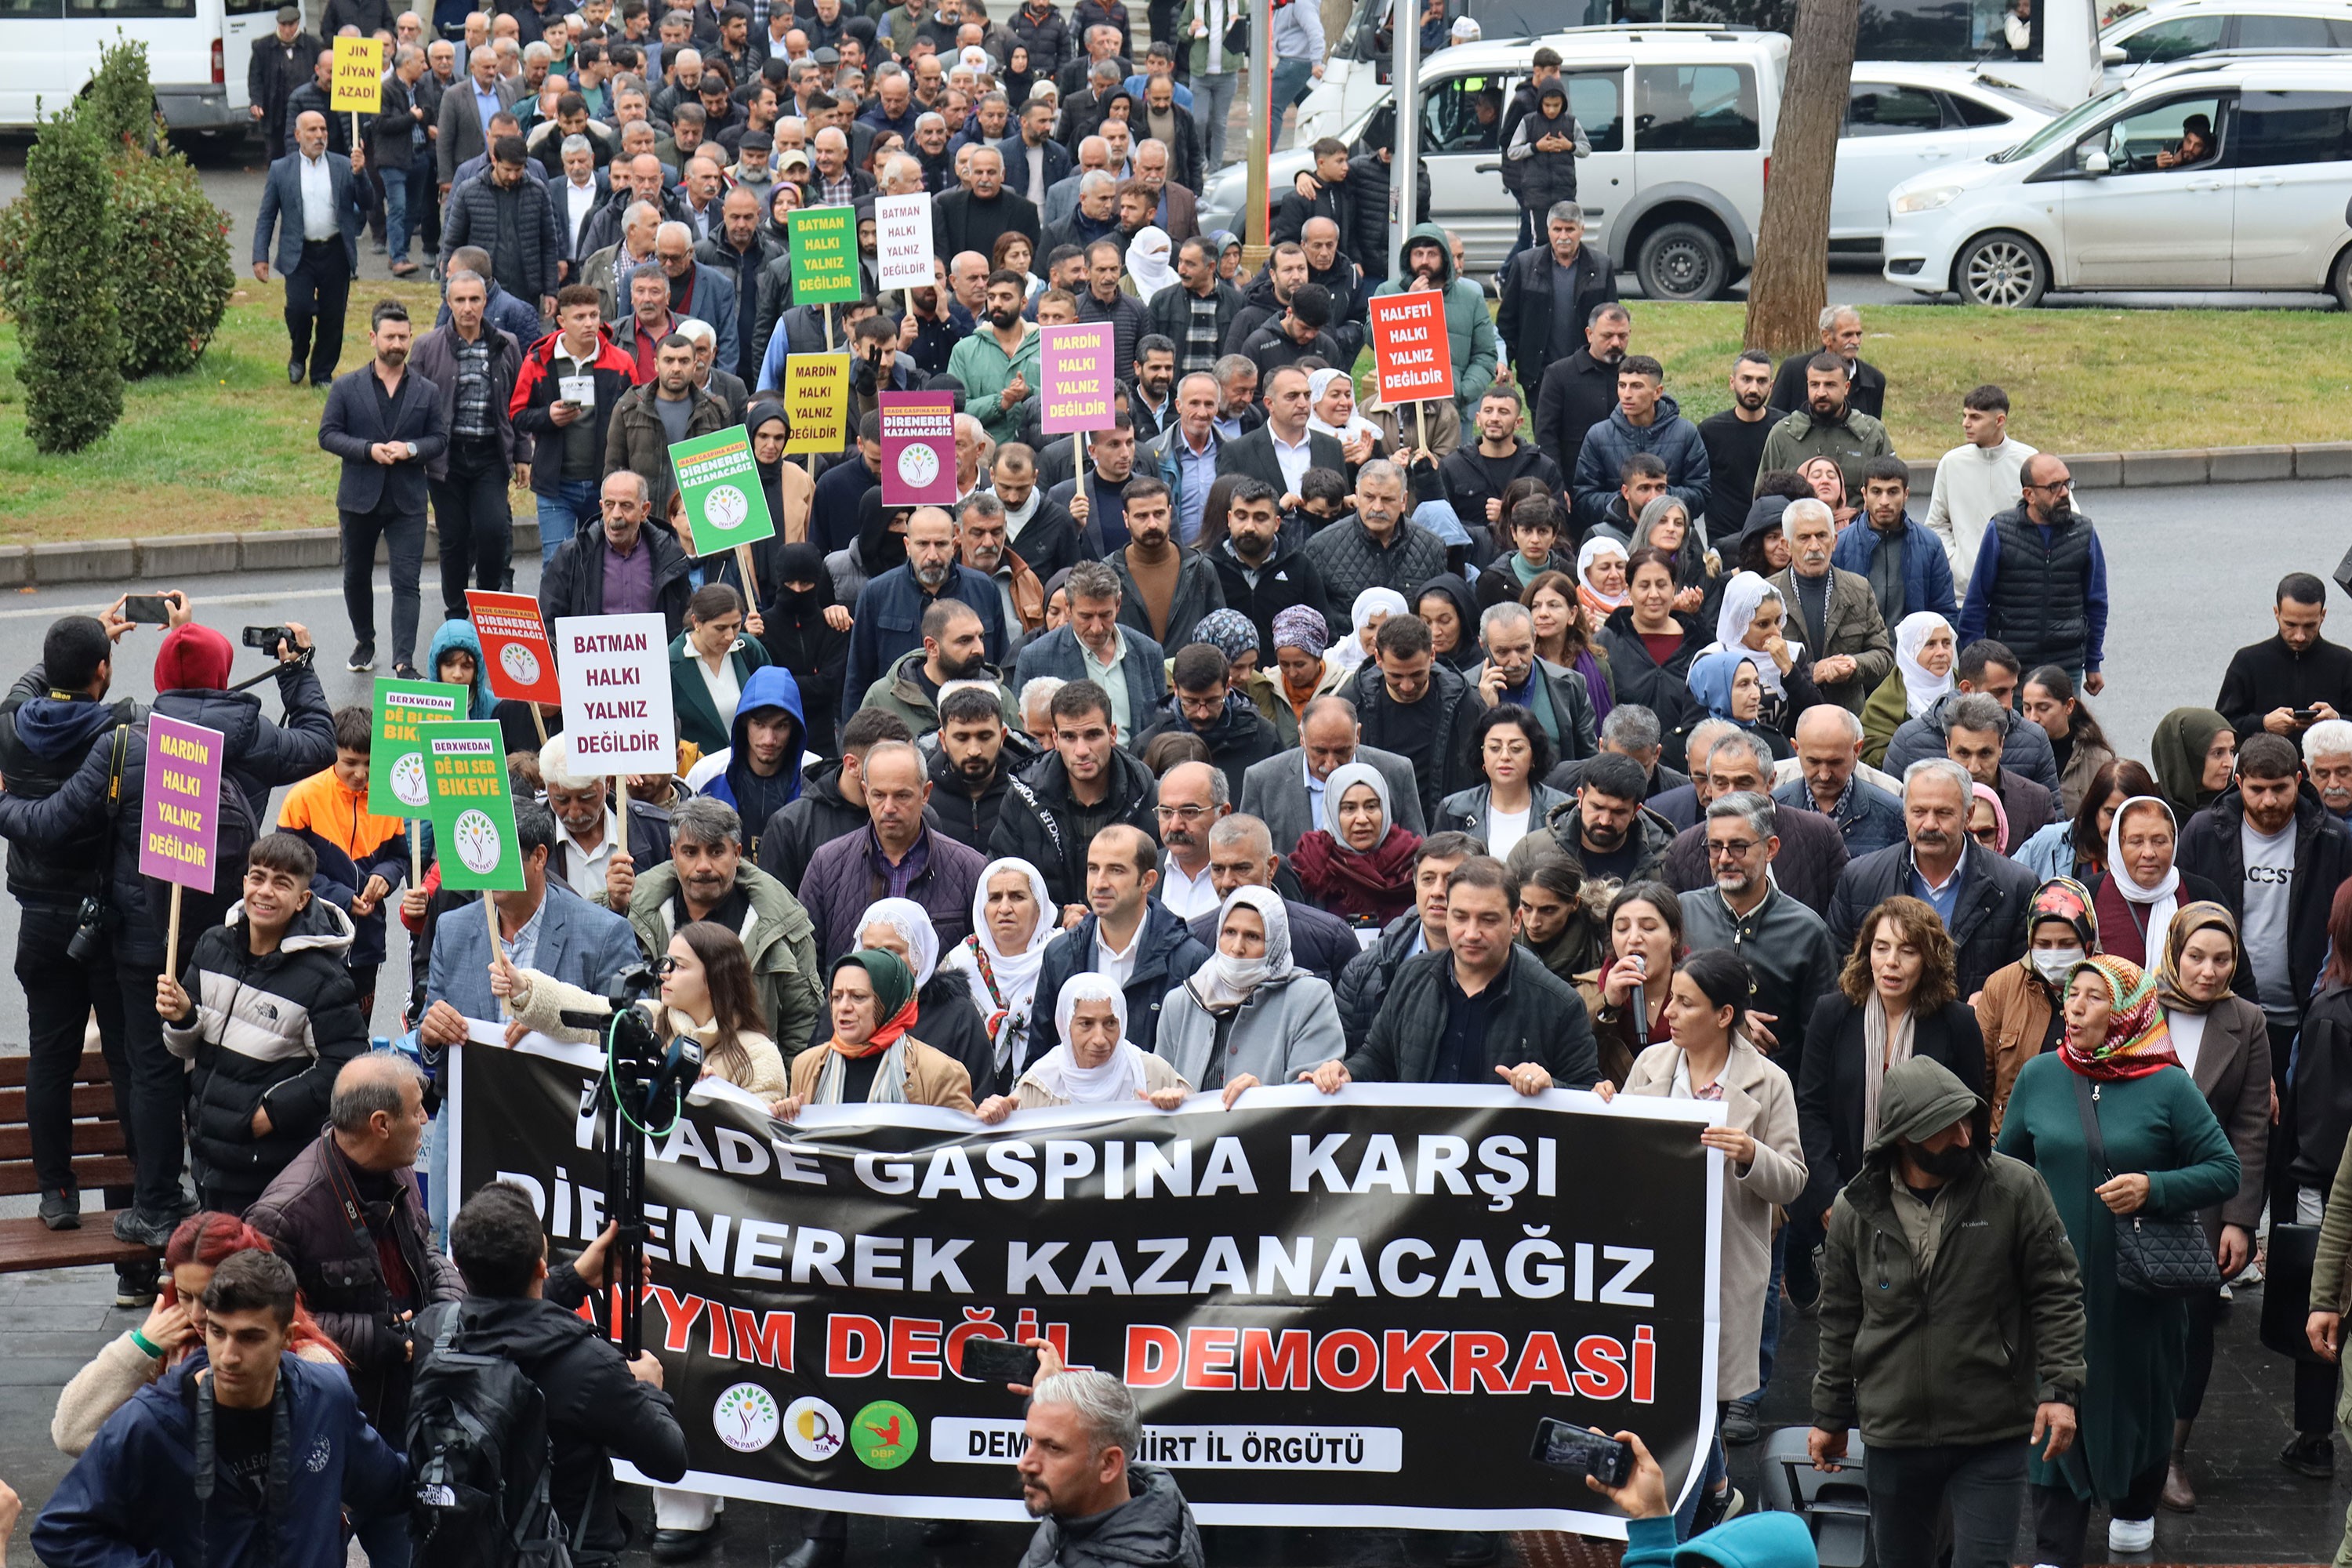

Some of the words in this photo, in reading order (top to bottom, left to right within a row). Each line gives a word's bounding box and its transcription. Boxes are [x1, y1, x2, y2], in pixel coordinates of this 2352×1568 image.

[348, 45, 368, 56] JIN
[339, 63, 375, 78] JİYAN
[338, 85, 375, 99] AZADİ
[883, 205, 920, 219] BATMAN
[797, 217, 844, 232] BATMAN
[888, 225, 916, 238] HALKI
[805, 238, 840, 251] HALKI
[887, 244, 920, 257] YALNIZ
[804, 256, 844, 270] YALNIZ
[883, 262, 926, 277] DEĞİLDİR
[799, 274, 852, 291] DEĞİLDİR
[1380, 300, 1432, 322] HALFETİ
[1053, 332, 1101, 350] MARDİN
[1389, 326, 1428, 343] HALKI
[1058, 357, 1096, 372] HALKI
[1388, 348, 1434, 366] YALNIZ
[796, 362, 837, 378] MARDİN
[1385, 367, 1443, 389] DEĞİLDİR
[799, 386, 831, 398] HALKI
[1056, 379, 1099, 395] YALNIZ
[796, 407, 833, 419] YALNIZ
[1049, 398, 1106, 418] DEĞİLDİR
[884, 416, 952, 427] DİRENEREK
[789, 424, 837, 439] DEĞİLDİR
[679, 449, 750, 480] DİRENEREK
[476, 614, 542, 631] DİRENEREK
[574, 633, 648, 654] BATMAN
[586, 666, 641, 687] HALKI
[51, 691, 71, 700] Nikon
[389, 695, 452, 708] BERXWEDAN
[385, 707, 405, 722] DÊ
[407, 711, 422, 724] BI
[584, 699, 648, 720] YALNIZ
[383, 724, 420, 742] BIK
[577, 729, 660, 754] DEĞİLDİR
[160, 733, 209, 765] MARDİN
[434, 742, 491, 752] BERXWEDAN
[434, 757, 452, 775] DÊ
[455, 760, 469, 774] BI
[472, 760, 496, 775] SER
[110, 775, 118, 798] Nikon
[162, 768, 201, 797] HALKI
[437, 778, 500, 797] BIKEVE
[401, 793, 412, 802] DEM
[158, 801, 201, 832] YALNIZ
[149, 832, 206, 868] DEĞİLDİR
[468, 858, 479, 869] DEM
[2245, 866, 2294, 884] COS
[854, 1135, 1259, 1201] GASPINA
[1290, 1133, 1557, 1212] KARŞI
[345, 1200, 357, 1219] EOS
[1007, 1223, 1655, 1308] KAZANACAĞIZ
[1123, 1323, 1656, 1404] DEMOKRASİ
[725, 1434, 740, 1447] DEM
[968, 1430, 1029, 1457] DEM
[1131, 1431, 1197, 1461] İİRT
[1207, 1431, 1232, 1462] İL
[1242, 1432, 1364, 1465] ÖRGÜTÜ
[416, 1490, 441, 1499] NORTH
